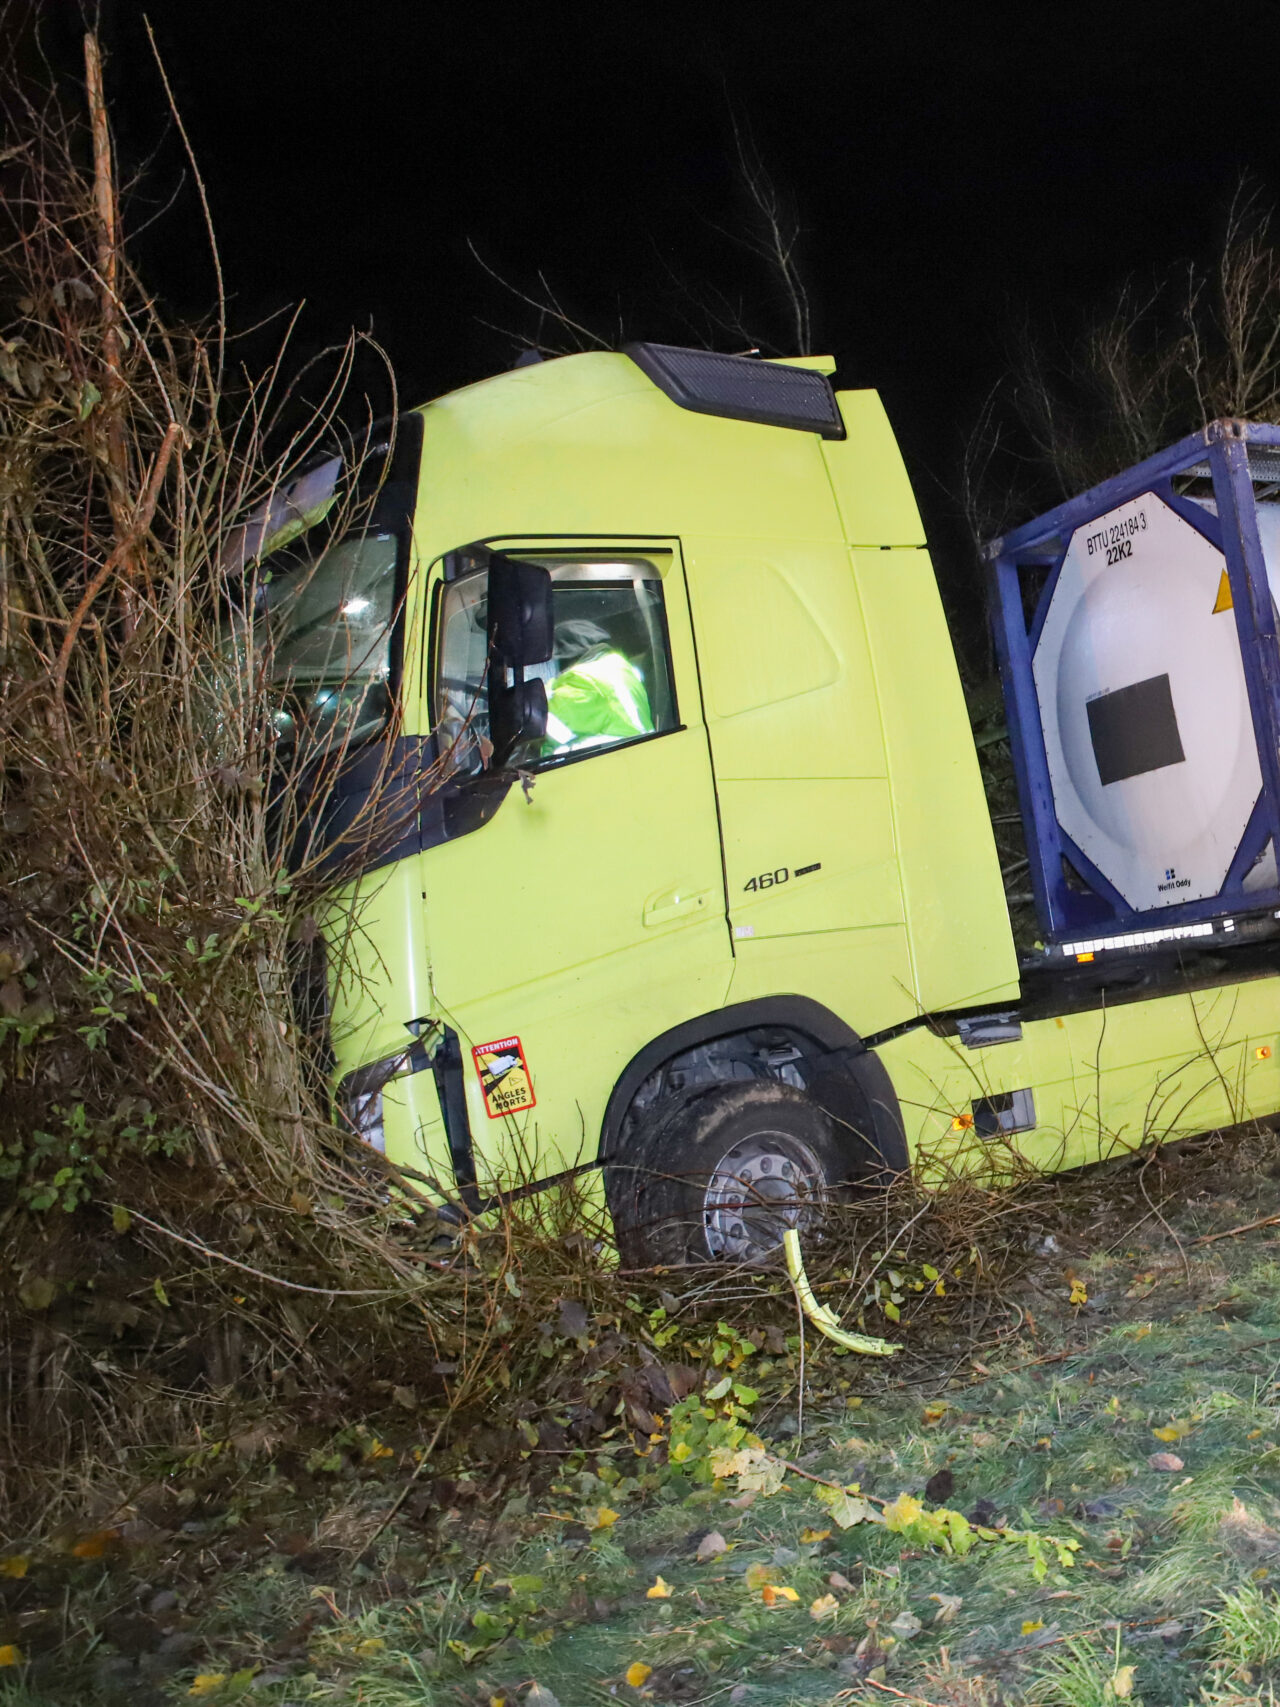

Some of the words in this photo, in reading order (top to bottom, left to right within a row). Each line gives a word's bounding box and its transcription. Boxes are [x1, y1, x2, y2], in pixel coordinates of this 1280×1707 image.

[1087, 530, 1109, 556] BTTU
[1110, 516, 1139, 544] 224184
[1140, 512, 1147, 530] 3
[1106, 540, 1133, 566] 22K2
[744, 868, 789, 892] 460
[1175, 878, 1191, 888] Oddy
[475, 1038, 519, 1055] ATTENTION
[493, 1088, 526, 1103] ANGLES
[496, 1096, 527, 1111] MORTS
